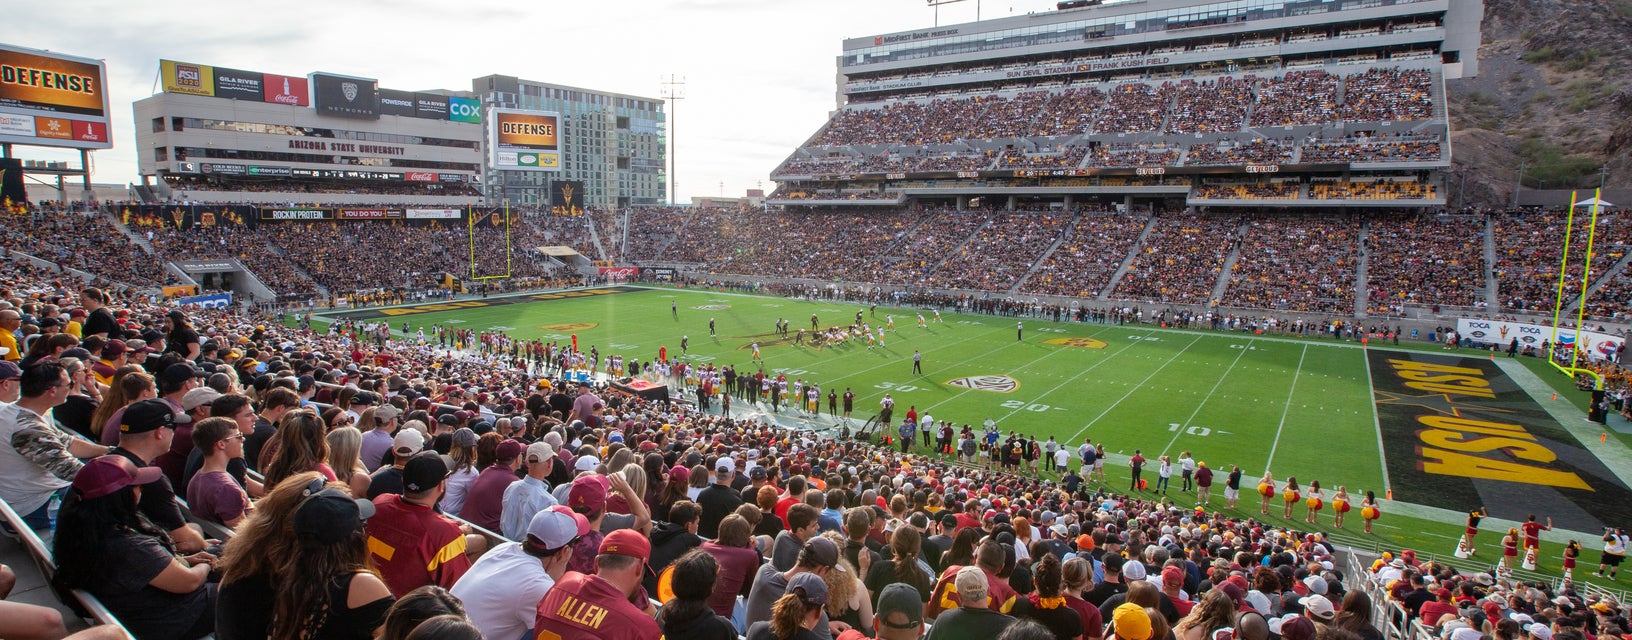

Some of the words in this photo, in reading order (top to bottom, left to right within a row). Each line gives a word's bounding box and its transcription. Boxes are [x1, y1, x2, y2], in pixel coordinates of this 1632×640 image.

[912, 32, 929, 41] BANK
[1023, 69, 1042, 77] DEVIL
[1044, 66, 1075, 75] STADIUM
[1092, 61, 1119, 70] FRANK
[1121, 59, 1143, 68] KUSH
[1146, 57, 1169, 66] FIELD
[1, 65, 94, 95] DEFENSE
[179, 71, 199, 80] ASU
[237, 78, 259, 86] RIVER
[275, 94, 298, 103] Coca-Cola
[328, 106, 373, 115] NETWORKS
[450, 103, 480, 117] COX
[503, 122, 553, 136] DEFENSE
[289, 140, 326, 150] ARIZONA
[331, 142, 355, 152] STATE
[359, 144, 405, 155] UNIVERSITY
[411, 172, 432, 181] Coca-Cola
[297, 210, 323, 219] PROTEIN
[1469, 321, 1490, 329] TOCA
[1519, 326, 1541, 334] TOCA
[1386, 358, 1497, 399] ASU
[873, 382, 918, 393] 30
[1000, 400, 1050, 412] 20
[1168, 423, 1212, 437] 10
[1415, 415, 1597, 493] ASU
[1526, 553, 1535, 565] SC
[556, 596, 609, 630] ALLEN
